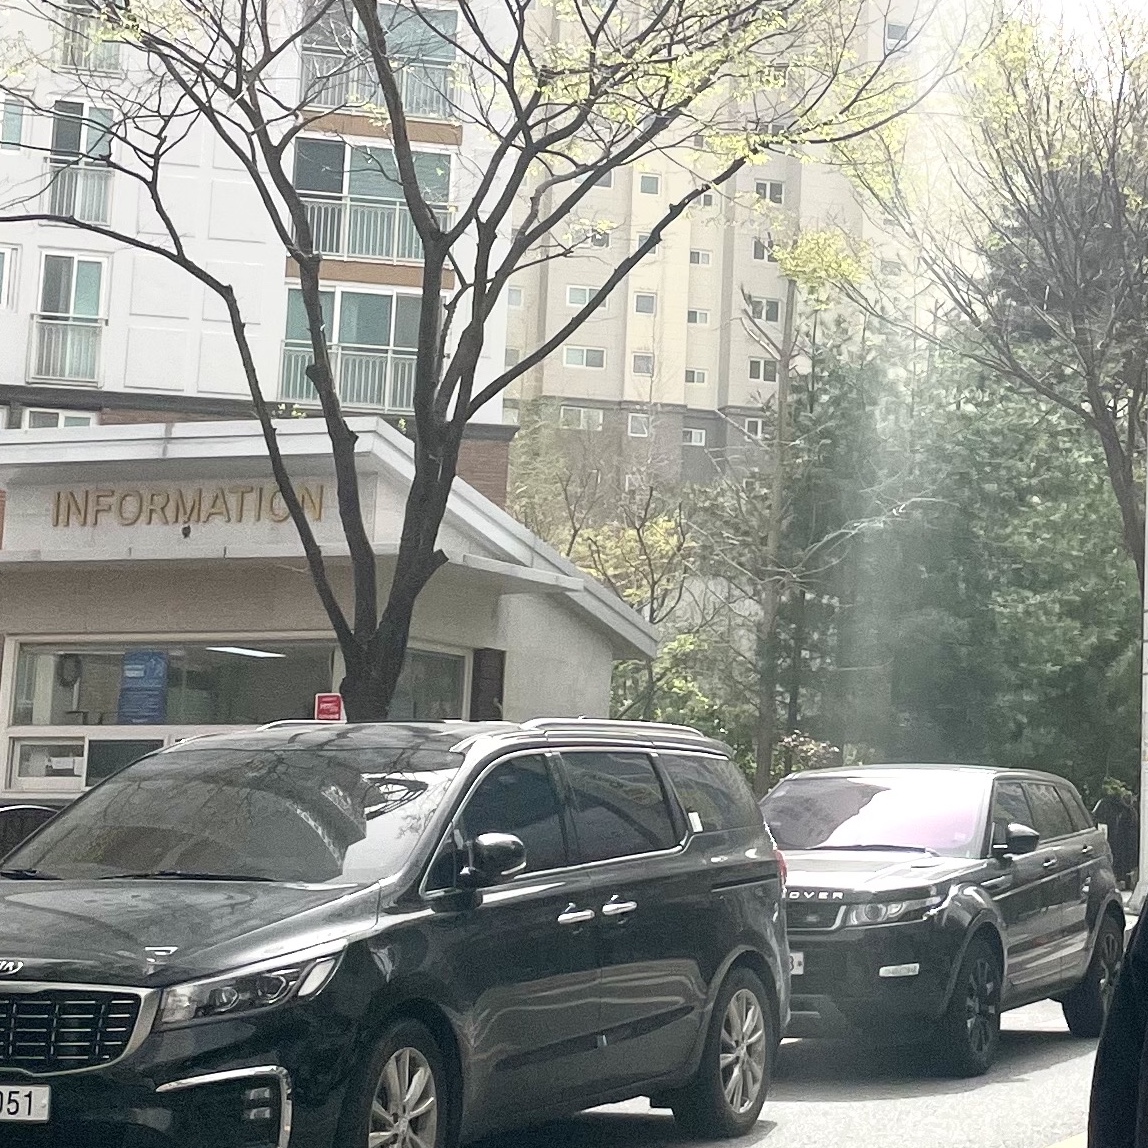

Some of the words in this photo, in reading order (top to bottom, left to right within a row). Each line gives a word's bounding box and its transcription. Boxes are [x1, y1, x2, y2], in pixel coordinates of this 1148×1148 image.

[52, 483, 325, 528] INFORMATION
[782, 891, 844, 900] OVER
[0, 1090, 33, 1117] 51
